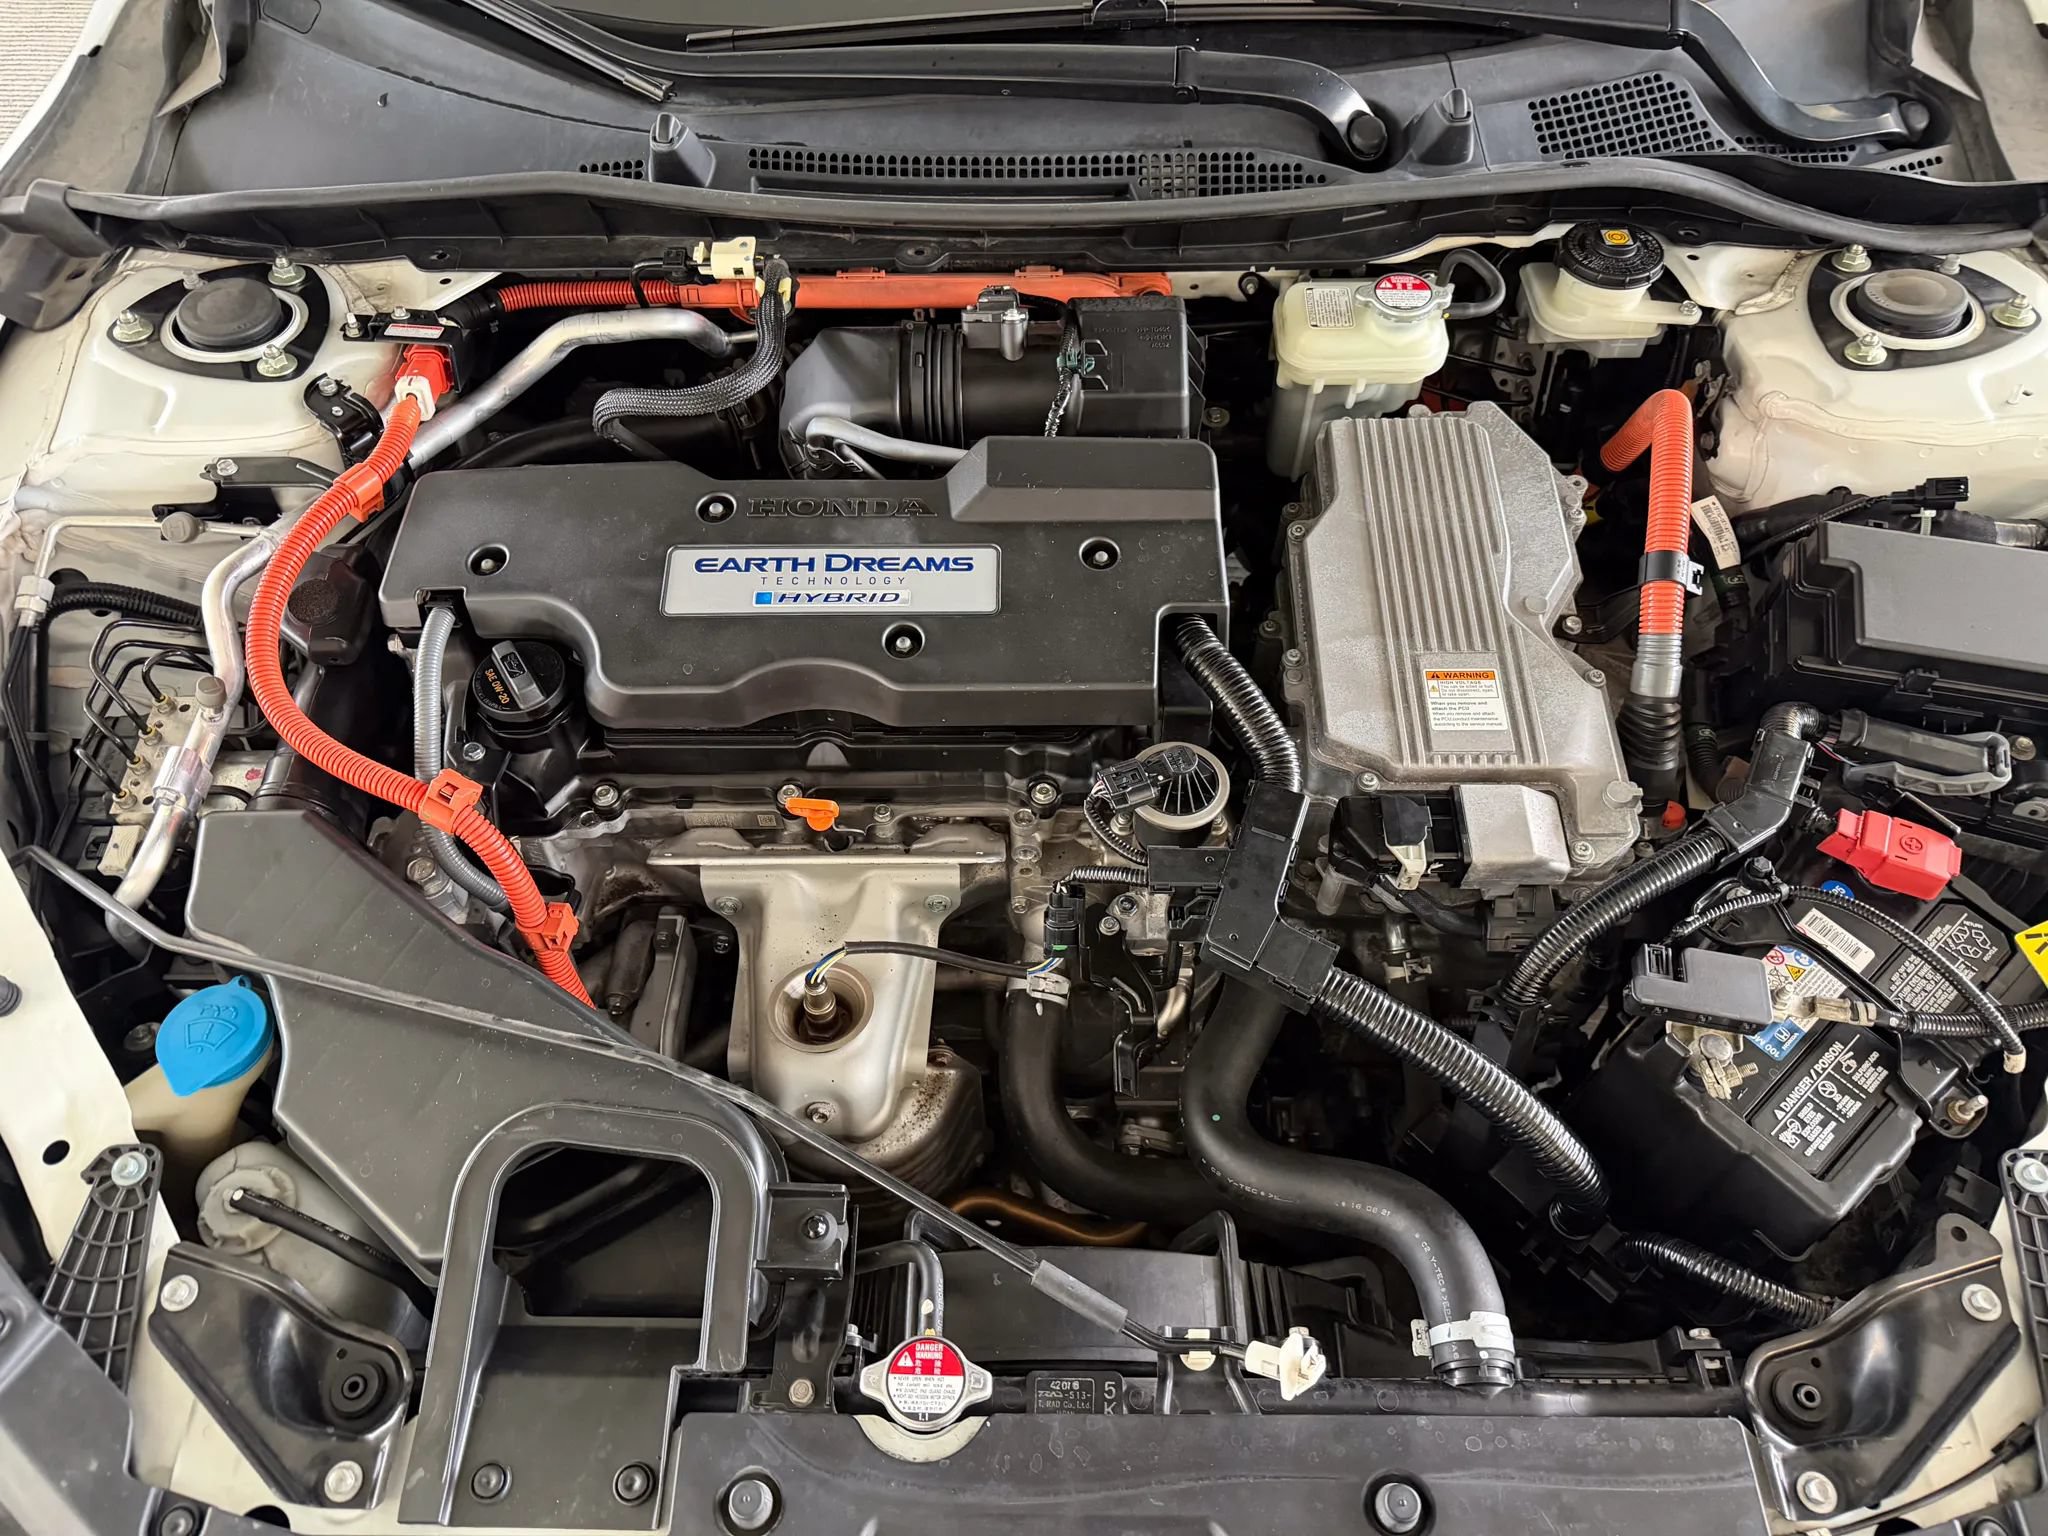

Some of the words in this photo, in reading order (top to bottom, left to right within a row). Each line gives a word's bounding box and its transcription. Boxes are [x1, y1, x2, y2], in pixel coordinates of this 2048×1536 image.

[747, 498, 938, 517] HONDA
[694, 557, 814, 573] EARTH
[825, 554, 974, 573] DREAMS
[761, 577, 905, 585] TECHNOLOGY
[778, 593, 901, 603] HYBRID
[485, 669, 497, 682] SAE
[1782, 1032, 1799, 1051] HONDA
[1765, 1044, 1780, 1058] 100
[1780, 1075, 1814, 1112] DANGER
[1814, 1041, 1844, 1074] POISON
[1104, 1381, 1116, 1399] 5
[1104, 1402, 1117, 1414] K
[919, 1413, 929, 1421] 1.1
